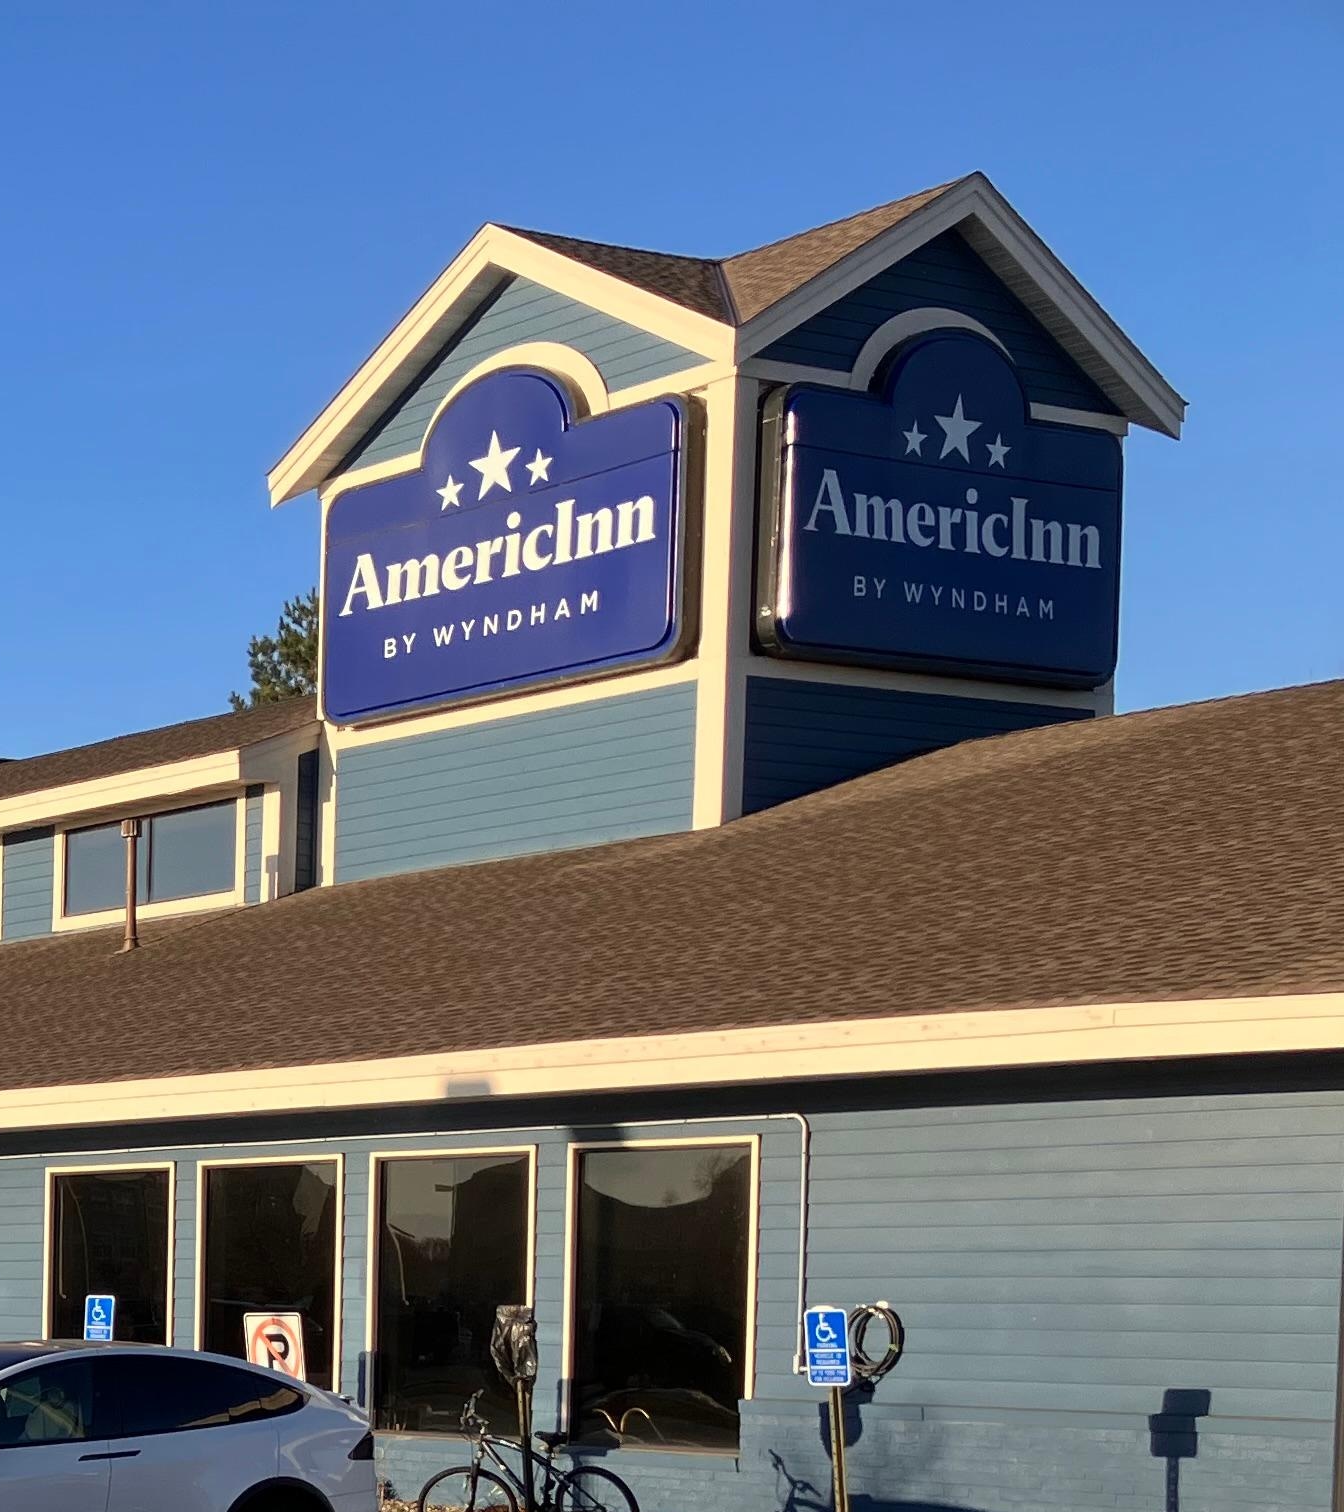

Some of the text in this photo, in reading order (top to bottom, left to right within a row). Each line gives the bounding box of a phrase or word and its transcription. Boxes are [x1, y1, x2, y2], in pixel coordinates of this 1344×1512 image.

[339, 495, 656, 617] AmericInn
[803, 468, 1102, 569] AmericInn
[383, 590, 599, 659] BY WYNDHAM
[854, 575, 1054, 620] BY WYNDHAM
